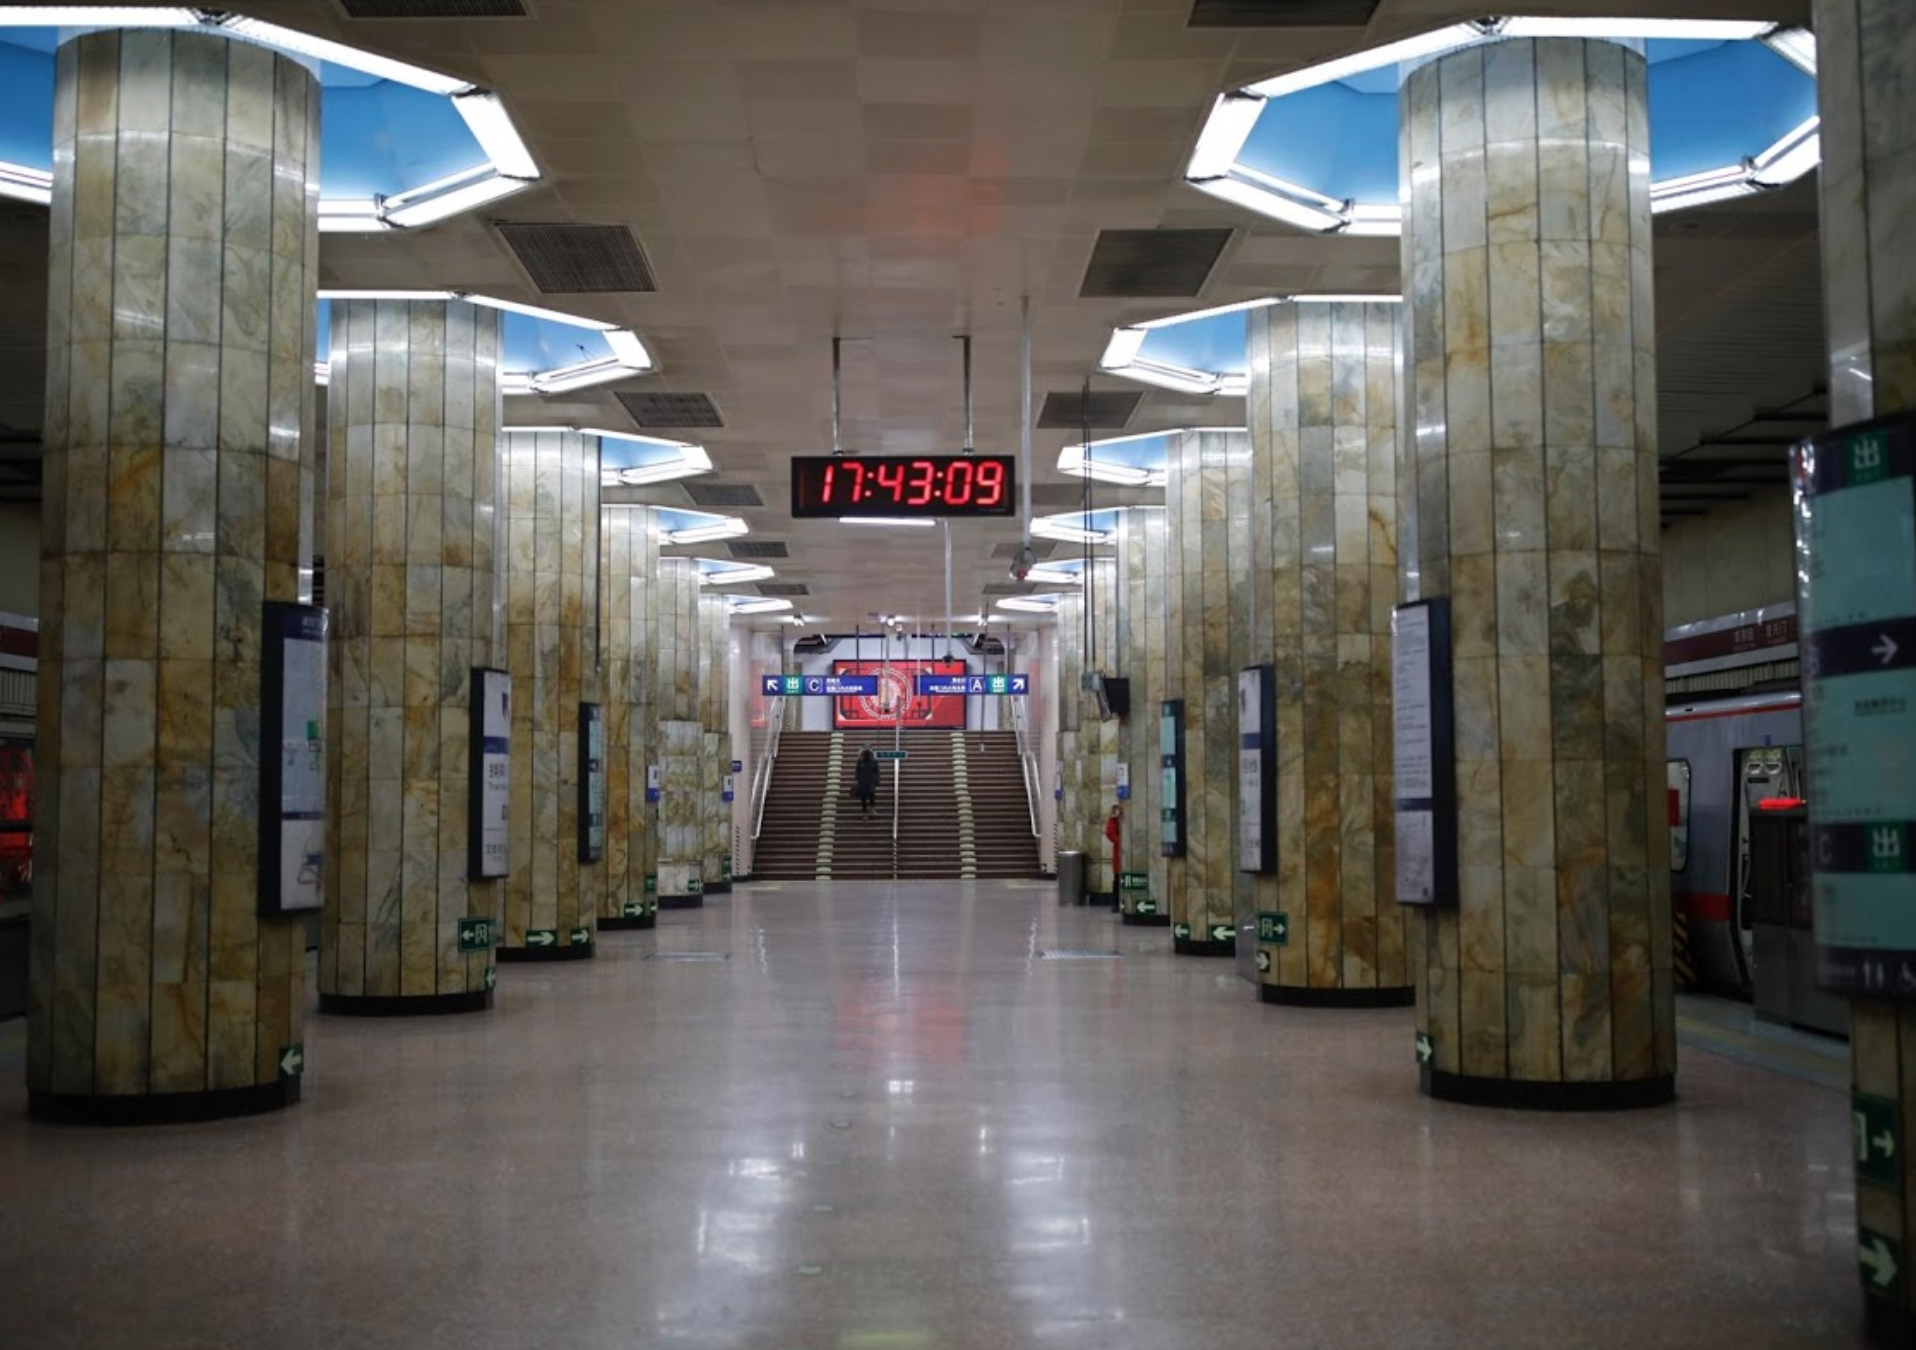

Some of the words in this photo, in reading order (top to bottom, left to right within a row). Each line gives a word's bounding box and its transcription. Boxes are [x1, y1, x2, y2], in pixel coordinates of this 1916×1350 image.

[1853, 437, 1881, 469] 出
[822, 460, 1004, 505] 17:43:09
[786, 676, 800, 690] 出
[808, 678, 820, 692] C
[972, 677, 983, 692] A
[992, 676, 1005, 688] 出
[1817, 832, 1834, 864] C
[1872, 826, 1900, 858] 出
